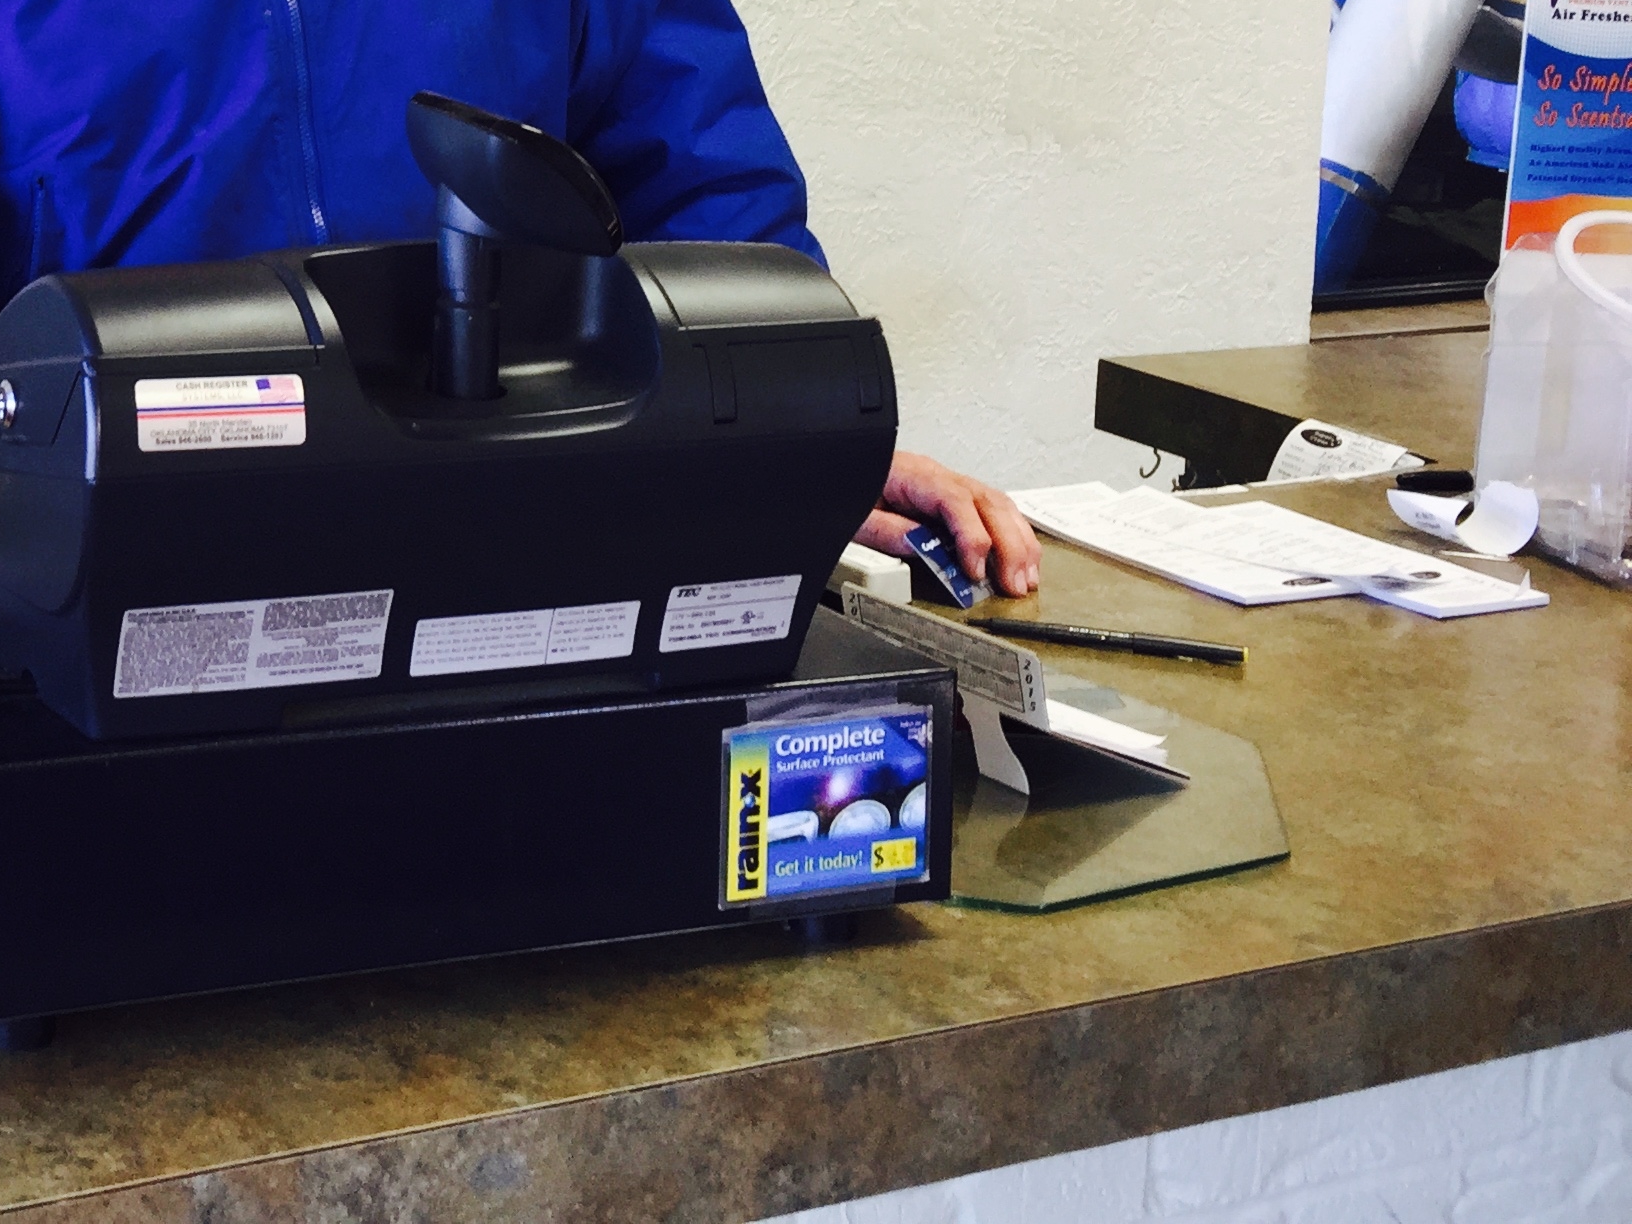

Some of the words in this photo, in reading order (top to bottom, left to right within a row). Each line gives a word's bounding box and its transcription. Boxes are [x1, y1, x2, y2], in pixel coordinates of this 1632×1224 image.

[1552, 8, 1577, 21] Air
[1580, 9, 1632, 23] Freshe
[1537, 63, 1563, 92] So
[1533, 100, 1559, 128] So
[175, 381, 201, 391] CASH
[203, 380, 249, 390] REGISTER
[775, 725, 886, 757] Complete
[776, 757, 820, 774] Surface
[823, 748, 885, 767] Protectant
[774, 859, 799, 877] Get
[804, 855, 814, 874] it
[819, 850, 863, 872] today!
[873, 845, 885, 868] $
